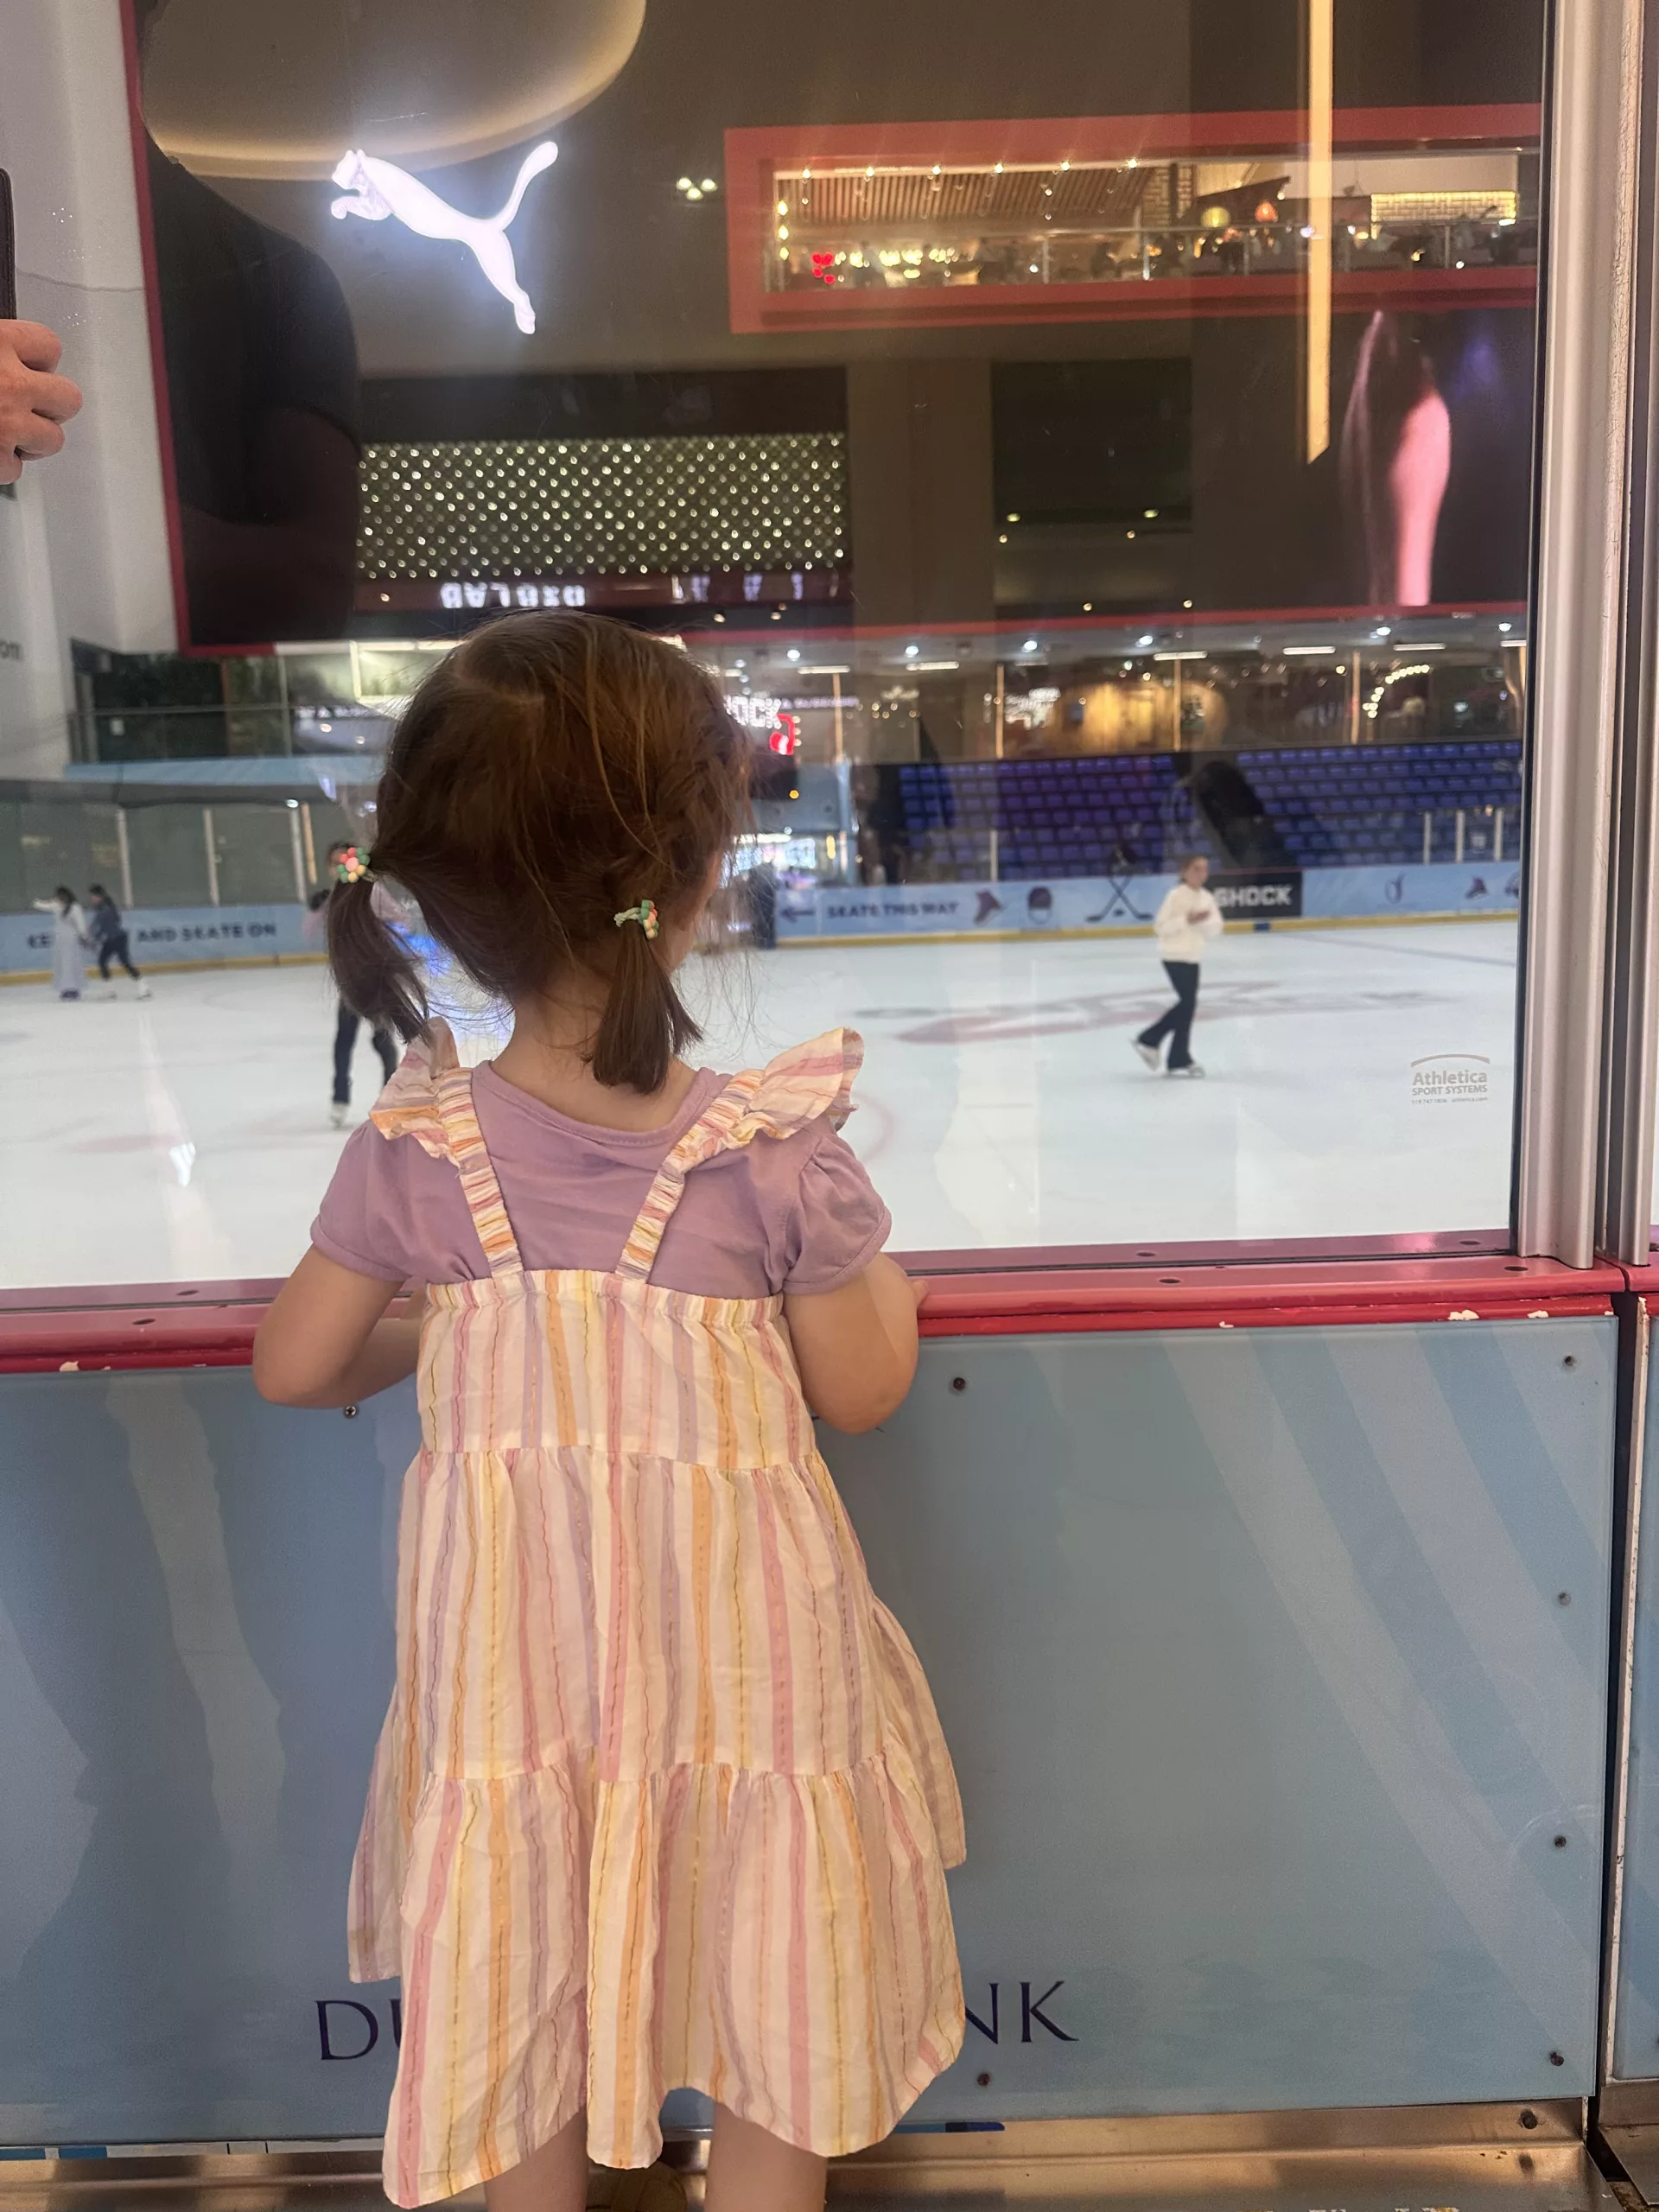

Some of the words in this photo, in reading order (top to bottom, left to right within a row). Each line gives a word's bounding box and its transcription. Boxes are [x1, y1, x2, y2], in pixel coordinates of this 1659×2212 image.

[137, 926, 177, 943] AND
[181, 922, 244, 942] SKATE
[246, 922, 277, 939] ON
[1412, 1070, 1488, 1085] Athletica
[1412, 1086, 1443, 1096] SPORT
[1446, 1084, 1488, 1094] SYSTEMS
